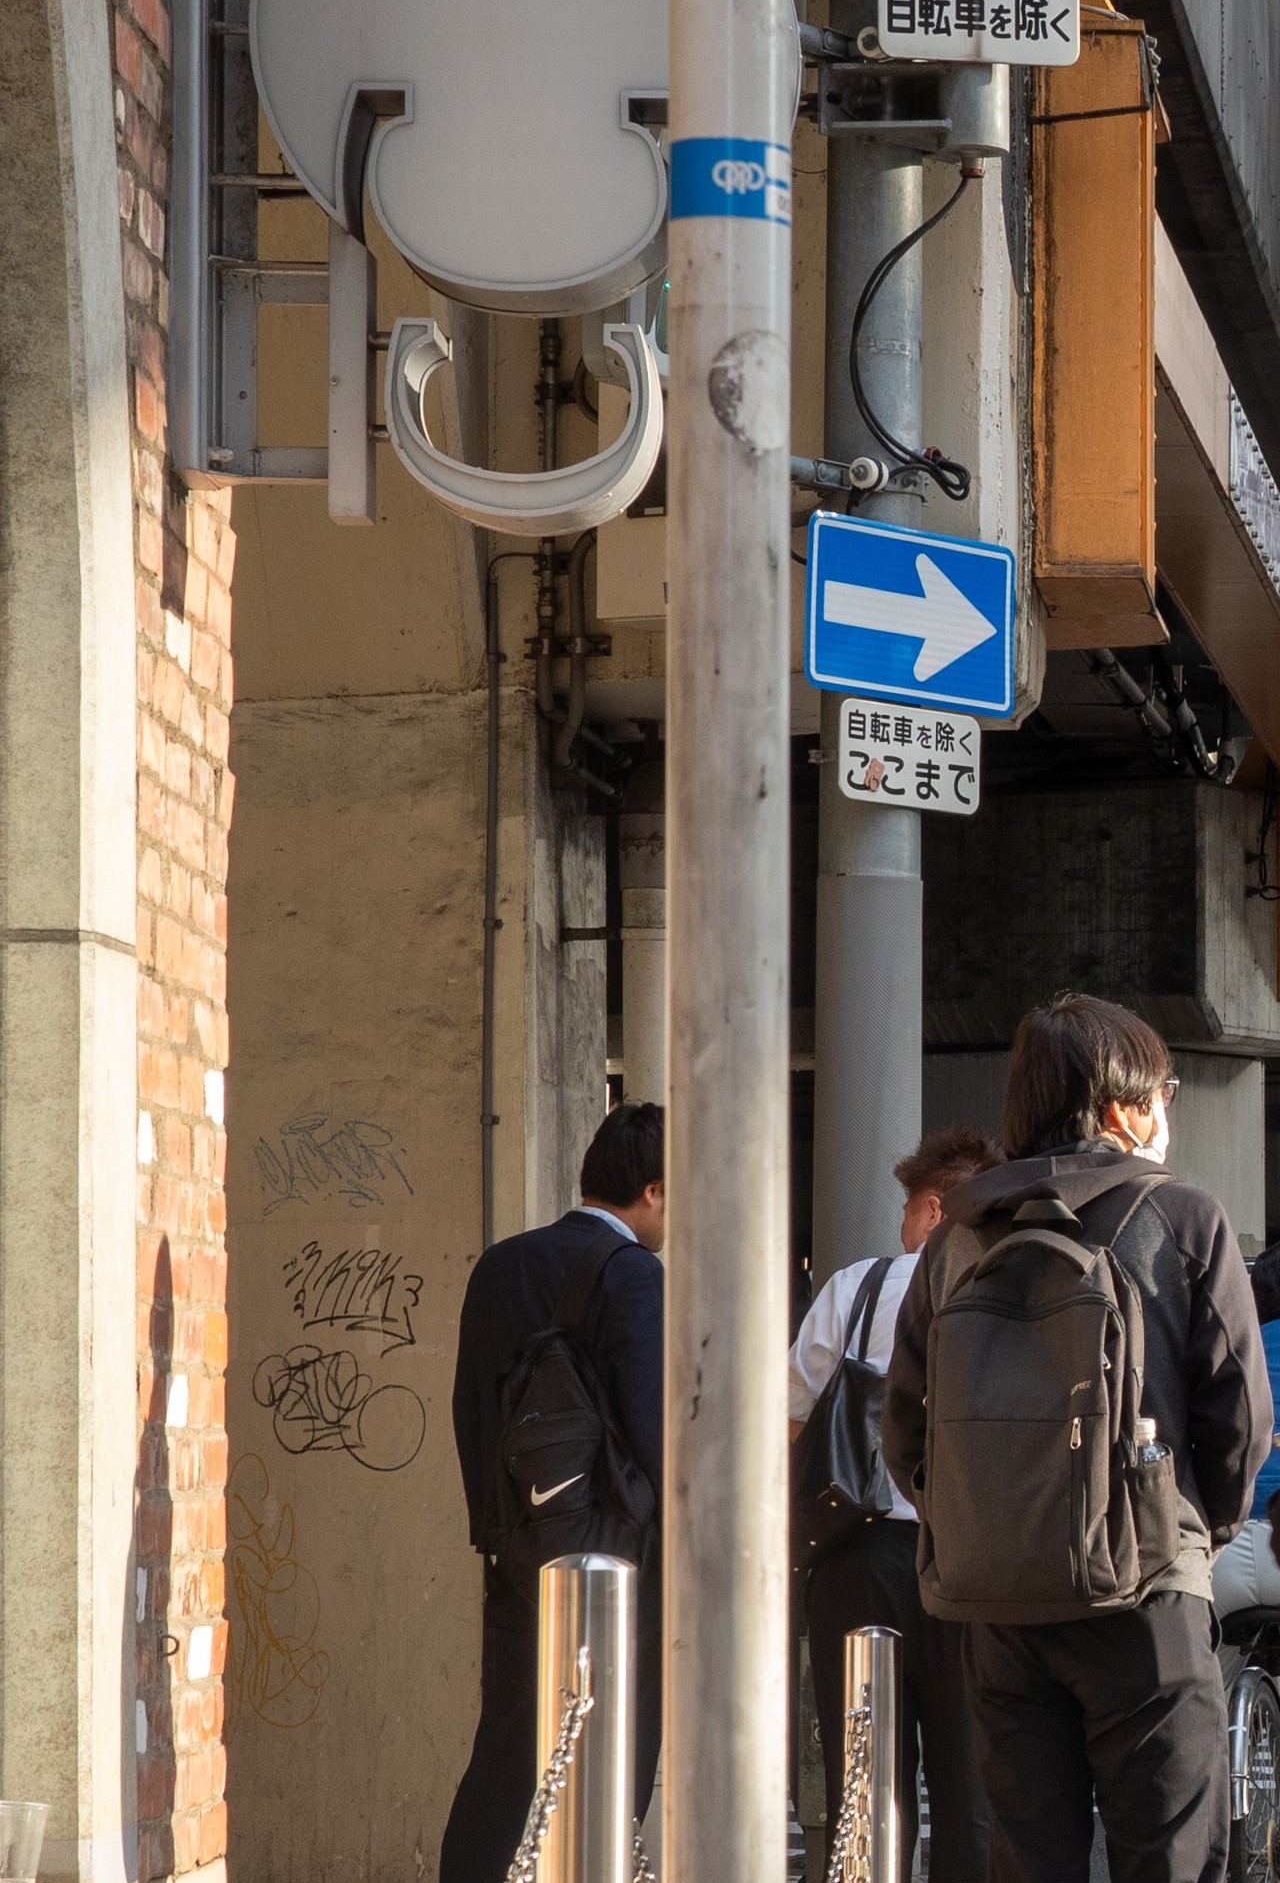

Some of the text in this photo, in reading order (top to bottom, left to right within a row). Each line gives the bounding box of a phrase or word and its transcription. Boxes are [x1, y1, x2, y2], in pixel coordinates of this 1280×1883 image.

[847, 709, 974, 757] 自転車を除く
[846, 749, 976, 806] ここまで
